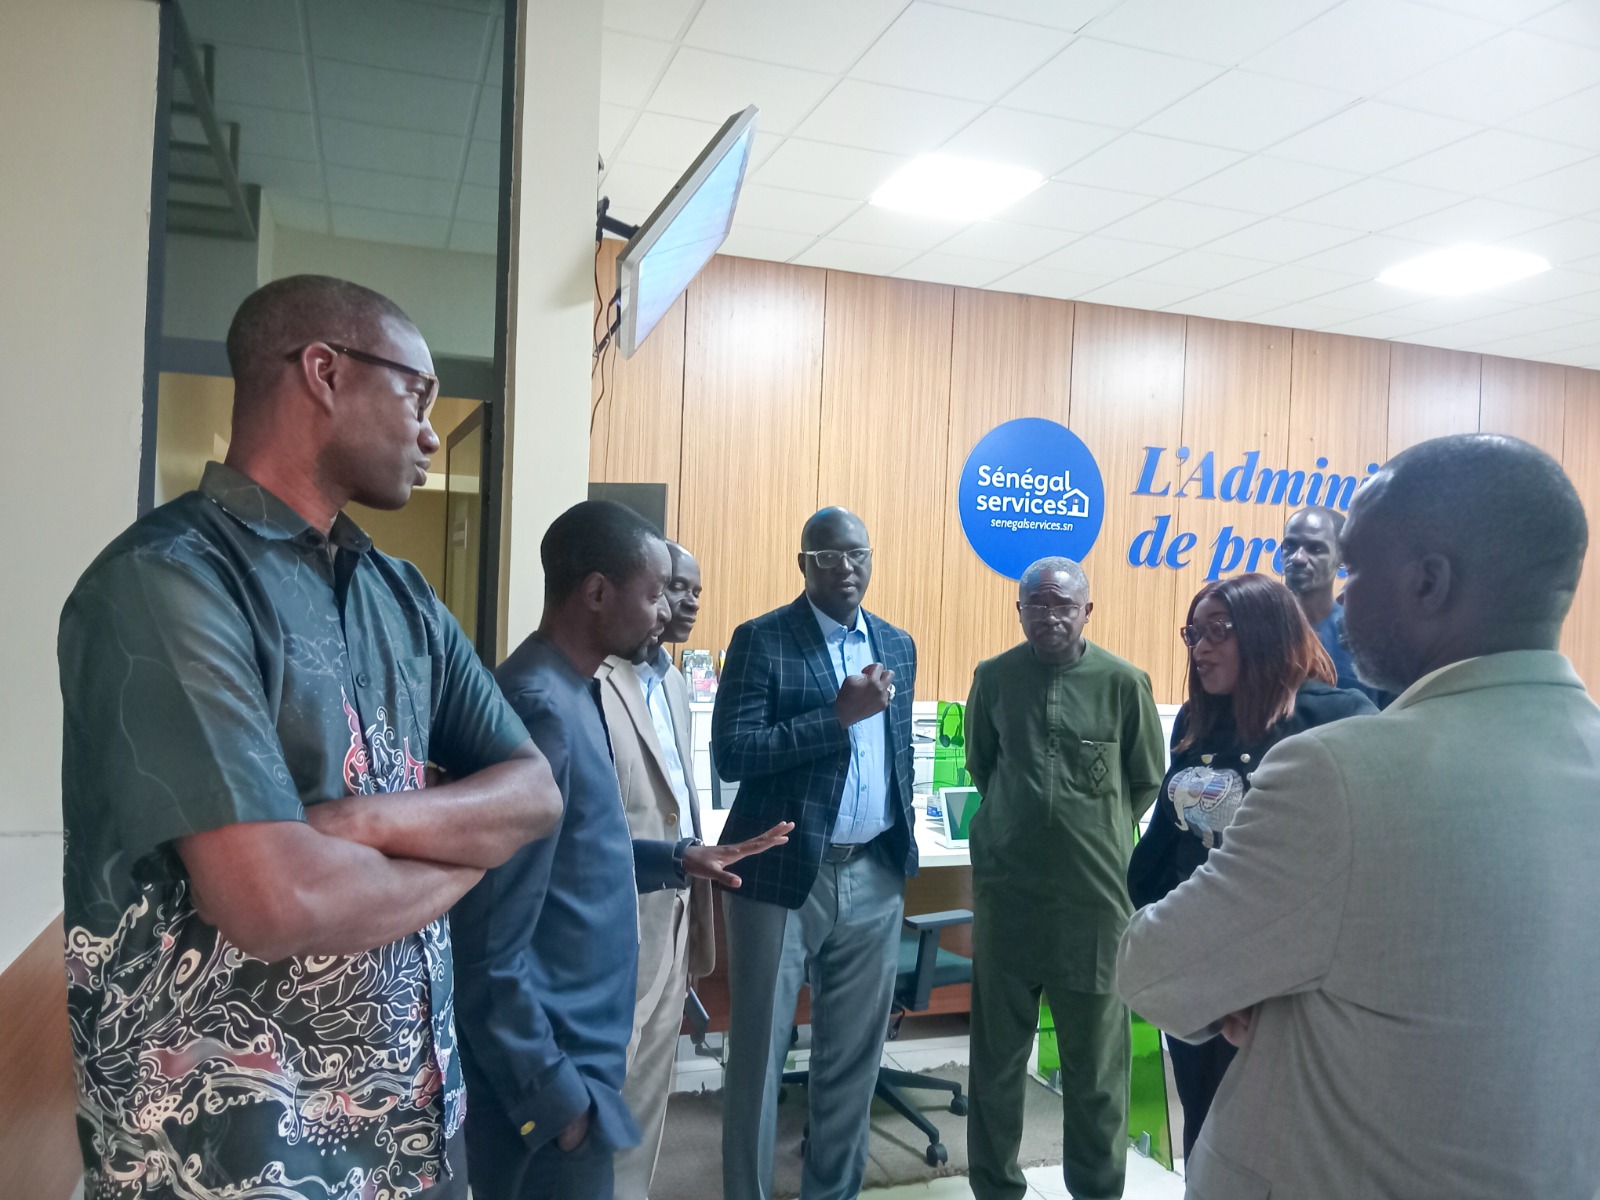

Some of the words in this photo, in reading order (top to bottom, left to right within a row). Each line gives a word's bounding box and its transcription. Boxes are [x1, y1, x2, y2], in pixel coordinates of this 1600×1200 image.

[977, 464, 1072, 496] Sénégal
[976, 491, 1068, 515] services
[990, 518, 1074, 532] senegalservices.sn
[1127, 514, 1198, 569] de
